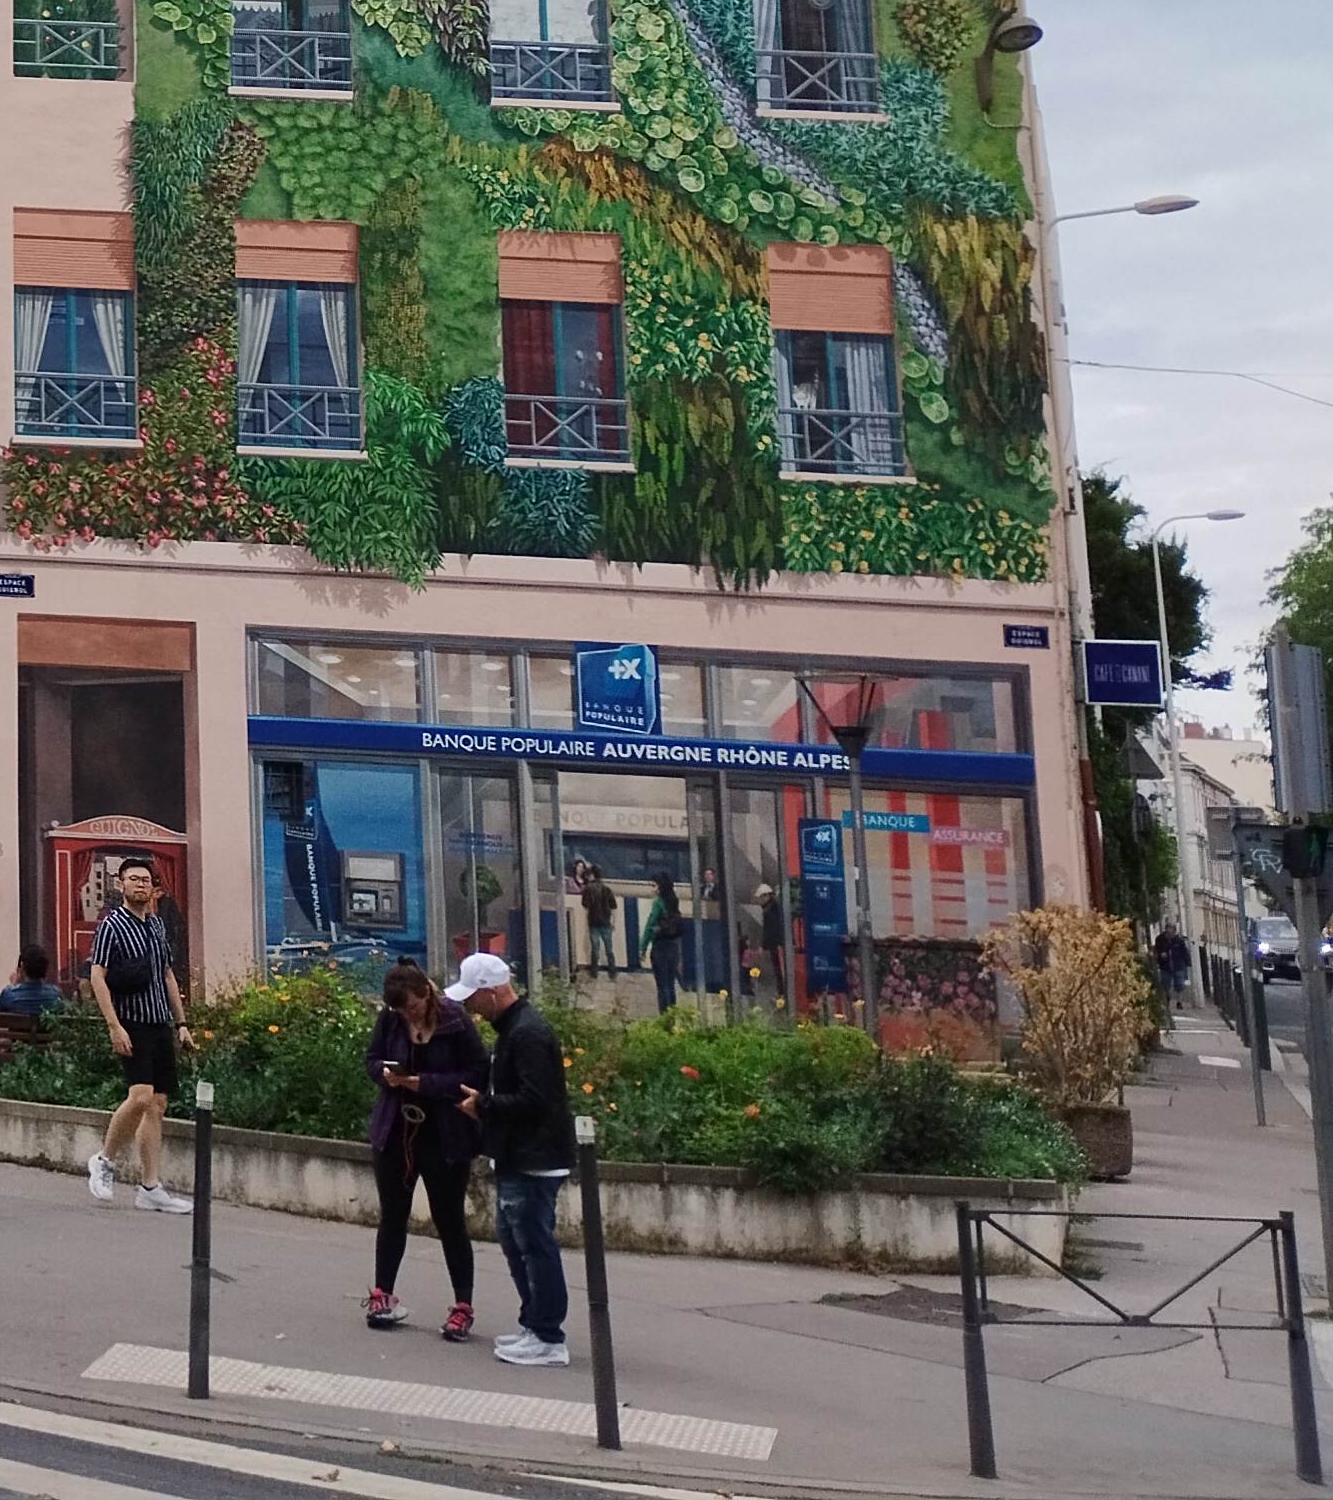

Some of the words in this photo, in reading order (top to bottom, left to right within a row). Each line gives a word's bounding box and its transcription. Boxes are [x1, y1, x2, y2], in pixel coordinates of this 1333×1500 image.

[585, 701, 644, 715] BANQUE
[585, 711, 644, 726] POPULAIRE
[423, 732, 497, 752] BANQUE
[501, 737, 595, 756] POPULAIRE
[603, 742, 712, 763] AUVERGNE
[717, 746, 789, 766] RHÔNE
[793, 751, 851, 770] ALPES
[90, 819, 158, 836] GUIGNOL
[934, 829, 1004, 844] ASSURANCE
[306, 843, 317, 881] BANQUE
[311, 883, 323, 932] POPULAIRE
